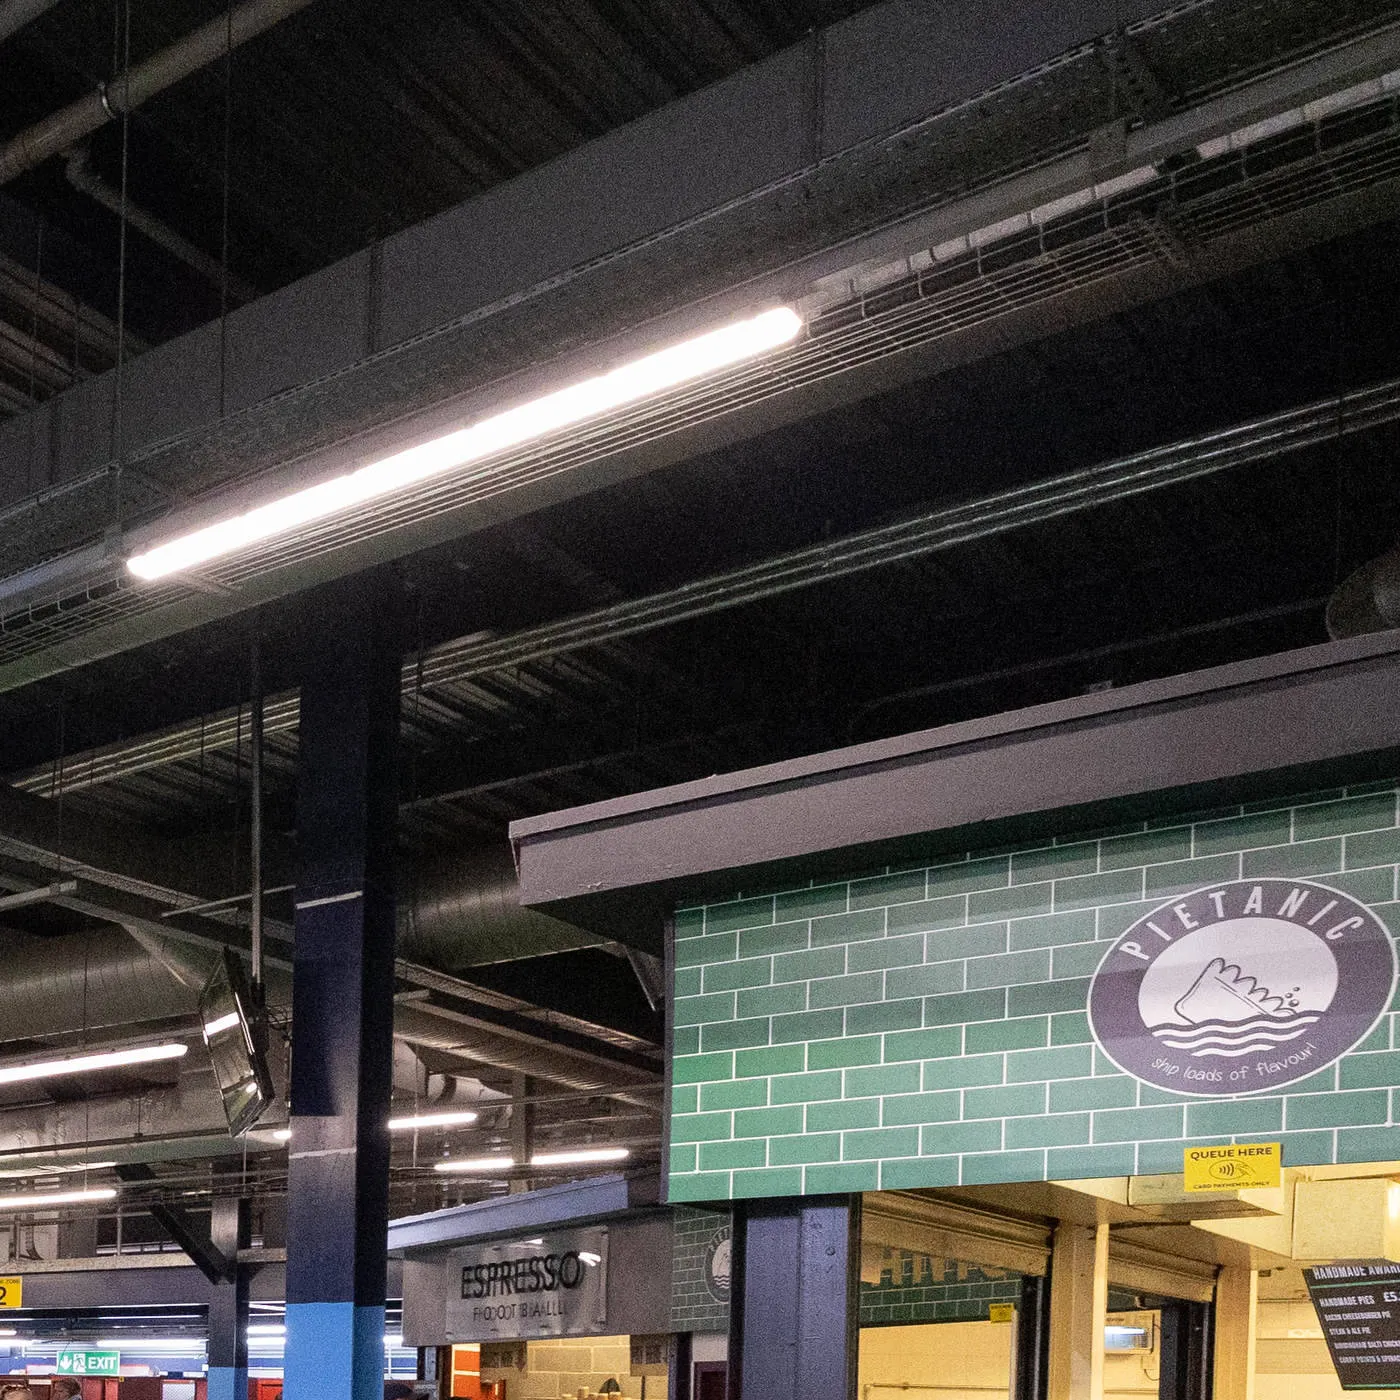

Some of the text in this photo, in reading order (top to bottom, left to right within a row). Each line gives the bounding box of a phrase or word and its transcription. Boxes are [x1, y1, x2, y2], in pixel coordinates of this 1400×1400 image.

[1119, 886, 1364, 961] PIETANIC
[1151, 1057, 1180, 1075] ship
[1183, 1066, 1222, 1082] loads
[1229, 1067, 1249, 1079] of
[1190, 1147, 1273, 1161] QUEUE HERE
[461, 1251, 582, 1299] ESPRESSO
[1368, 1265, 1400, 1275] AWAR
[1358, 1295, 1375, 1305] PIES
[1383, 1291, 1400, 1303] £5.
[88, 1356, 117, 1370] EXIT
